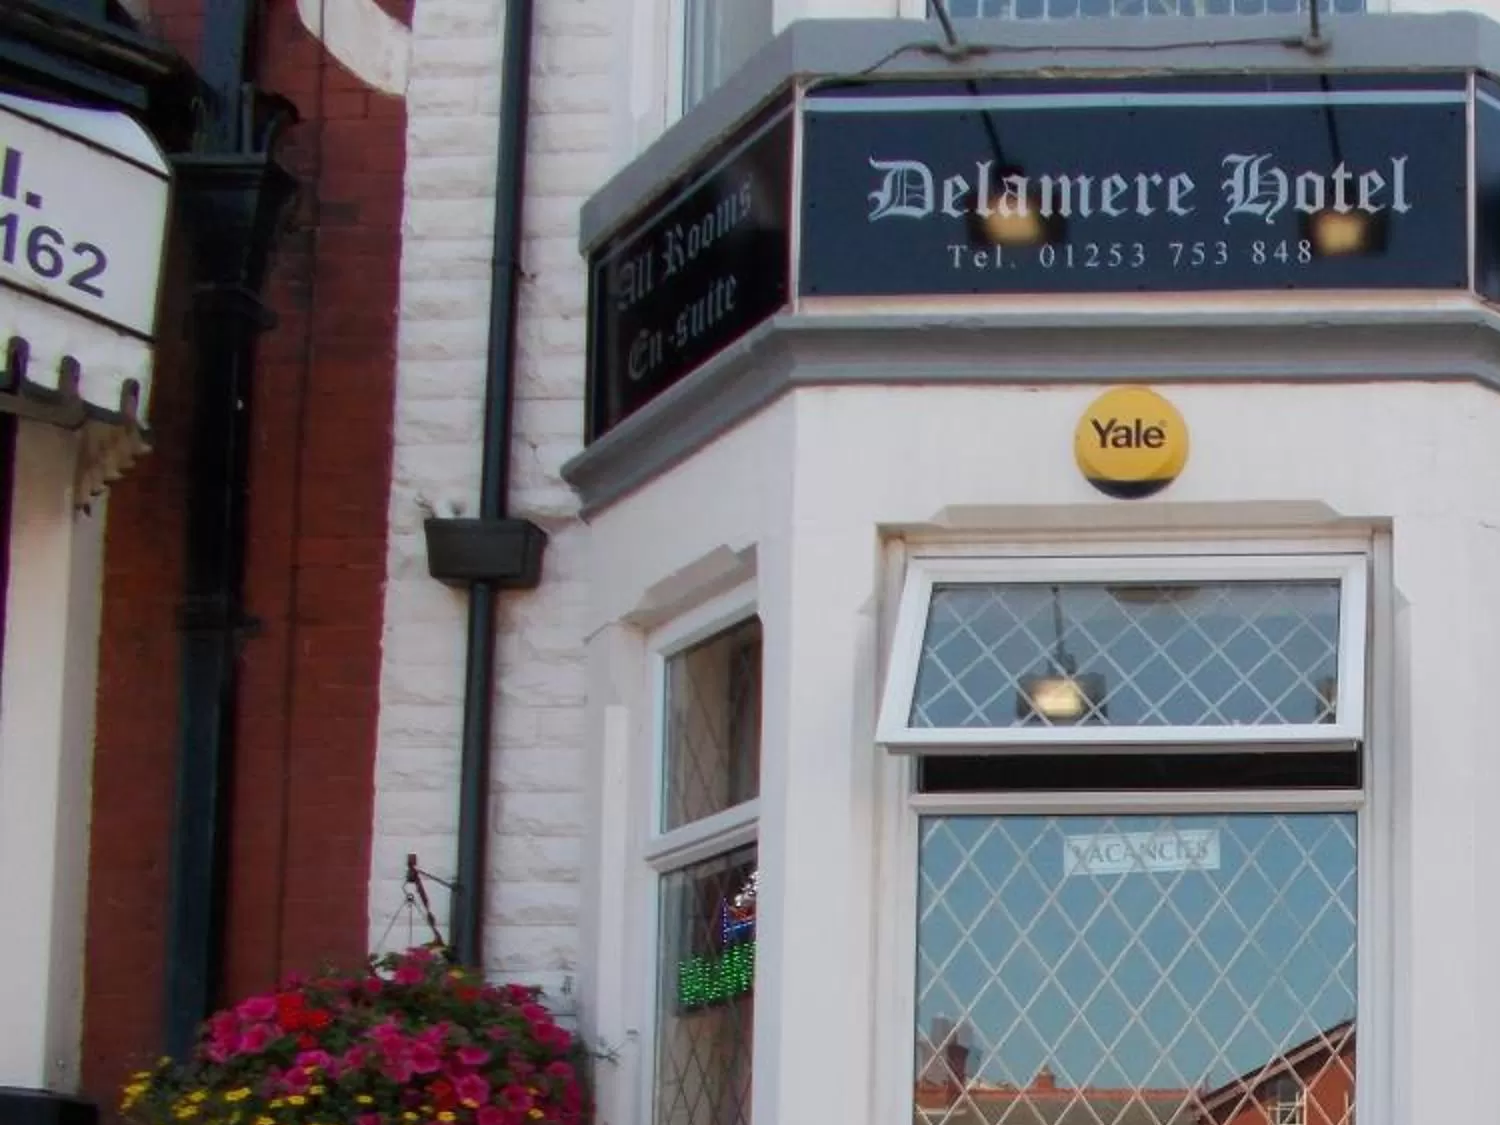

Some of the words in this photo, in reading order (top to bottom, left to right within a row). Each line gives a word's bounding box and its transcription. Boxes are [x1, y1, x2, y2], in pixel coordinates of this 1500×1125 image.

[867, 155, 1195, 223] Delamere
[1221, 153, 1412, 224] Hotel
[615, 245, 655, 311] All
[660, 180, 752, 278] Rooms
[947, 244, 1016, 269] Tel.
[1039, 243, 1145, 269] 01253
[1168, 241, 1228, 267] 753
[1252, 240, 1312, 265] 848
[627, 273, 737, 382] En-suite
[1090, 417, 1166, 449] Yale
